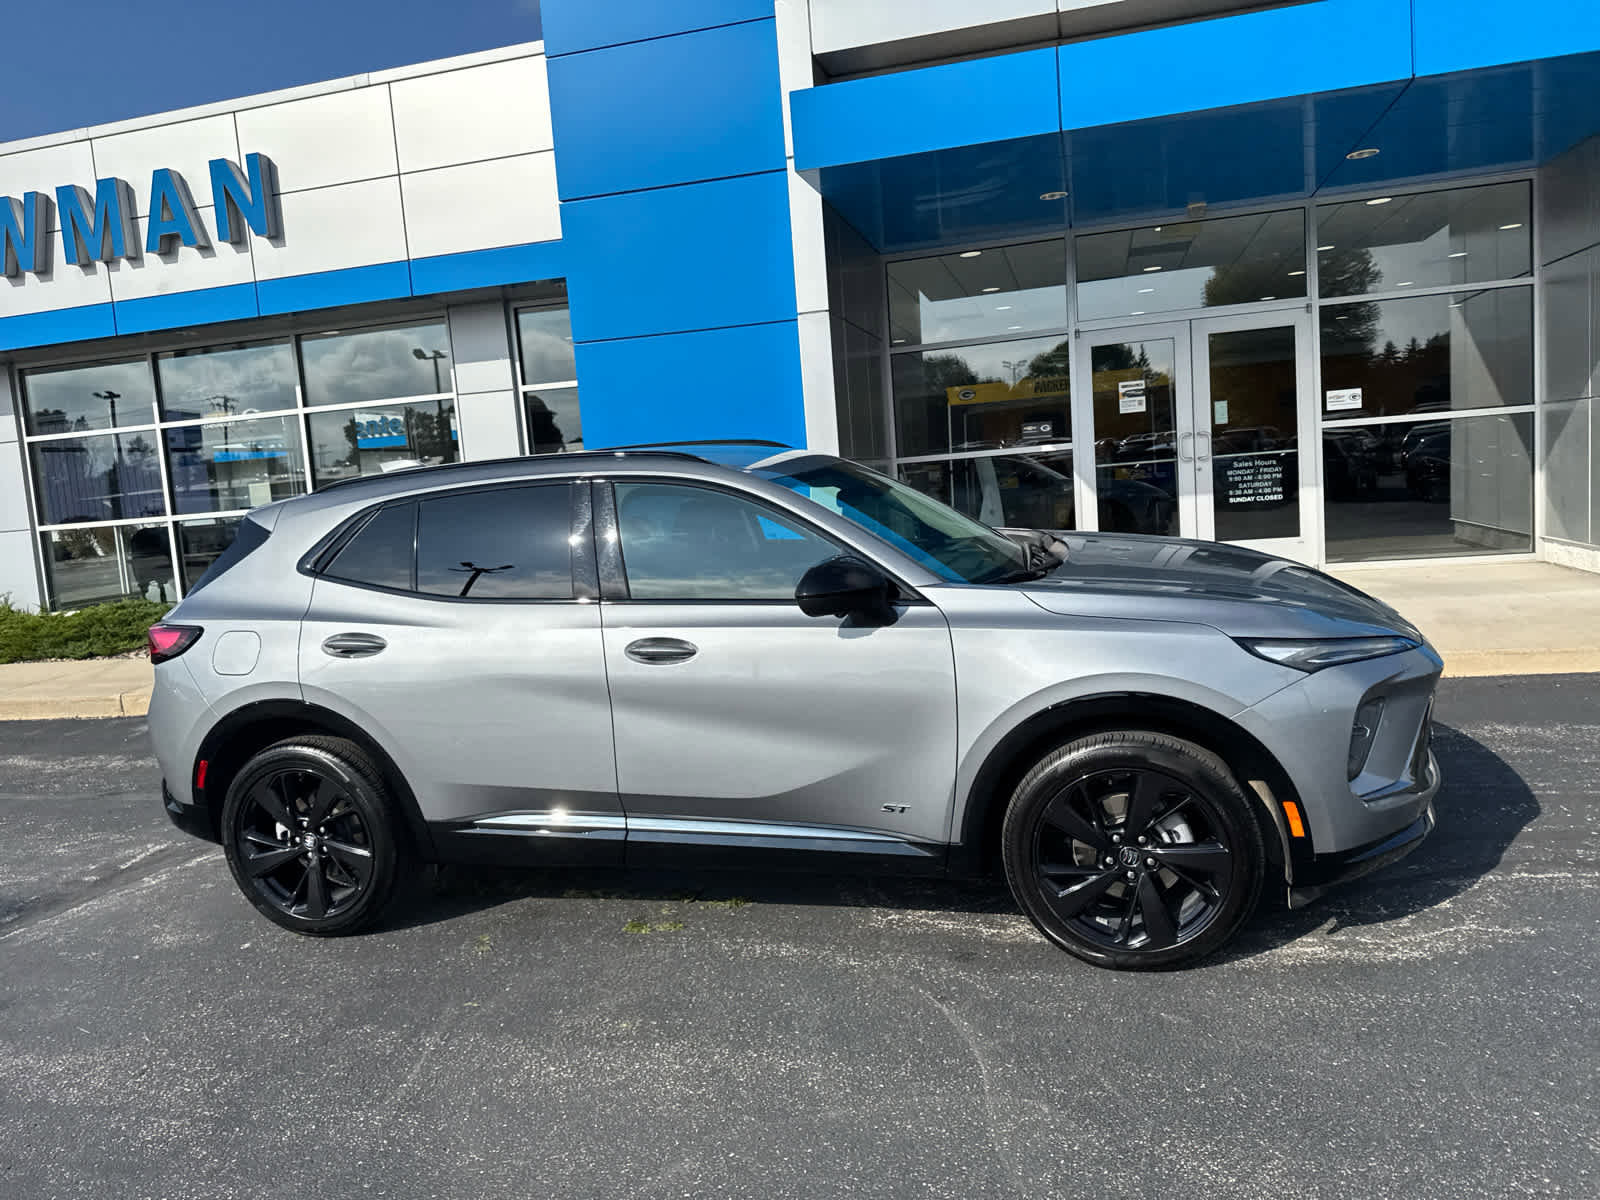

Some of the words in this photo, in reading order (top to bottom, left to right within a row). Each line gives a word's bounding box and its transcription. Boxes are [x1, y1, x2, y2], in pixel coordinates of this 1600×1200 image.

[1233, 460, 1253, 468] Sales
[1226, 468, 1254, 476] MONDAY
[1228, 495, 1255, 503] SUNDAY
[880, 803, 911, 813] ST
